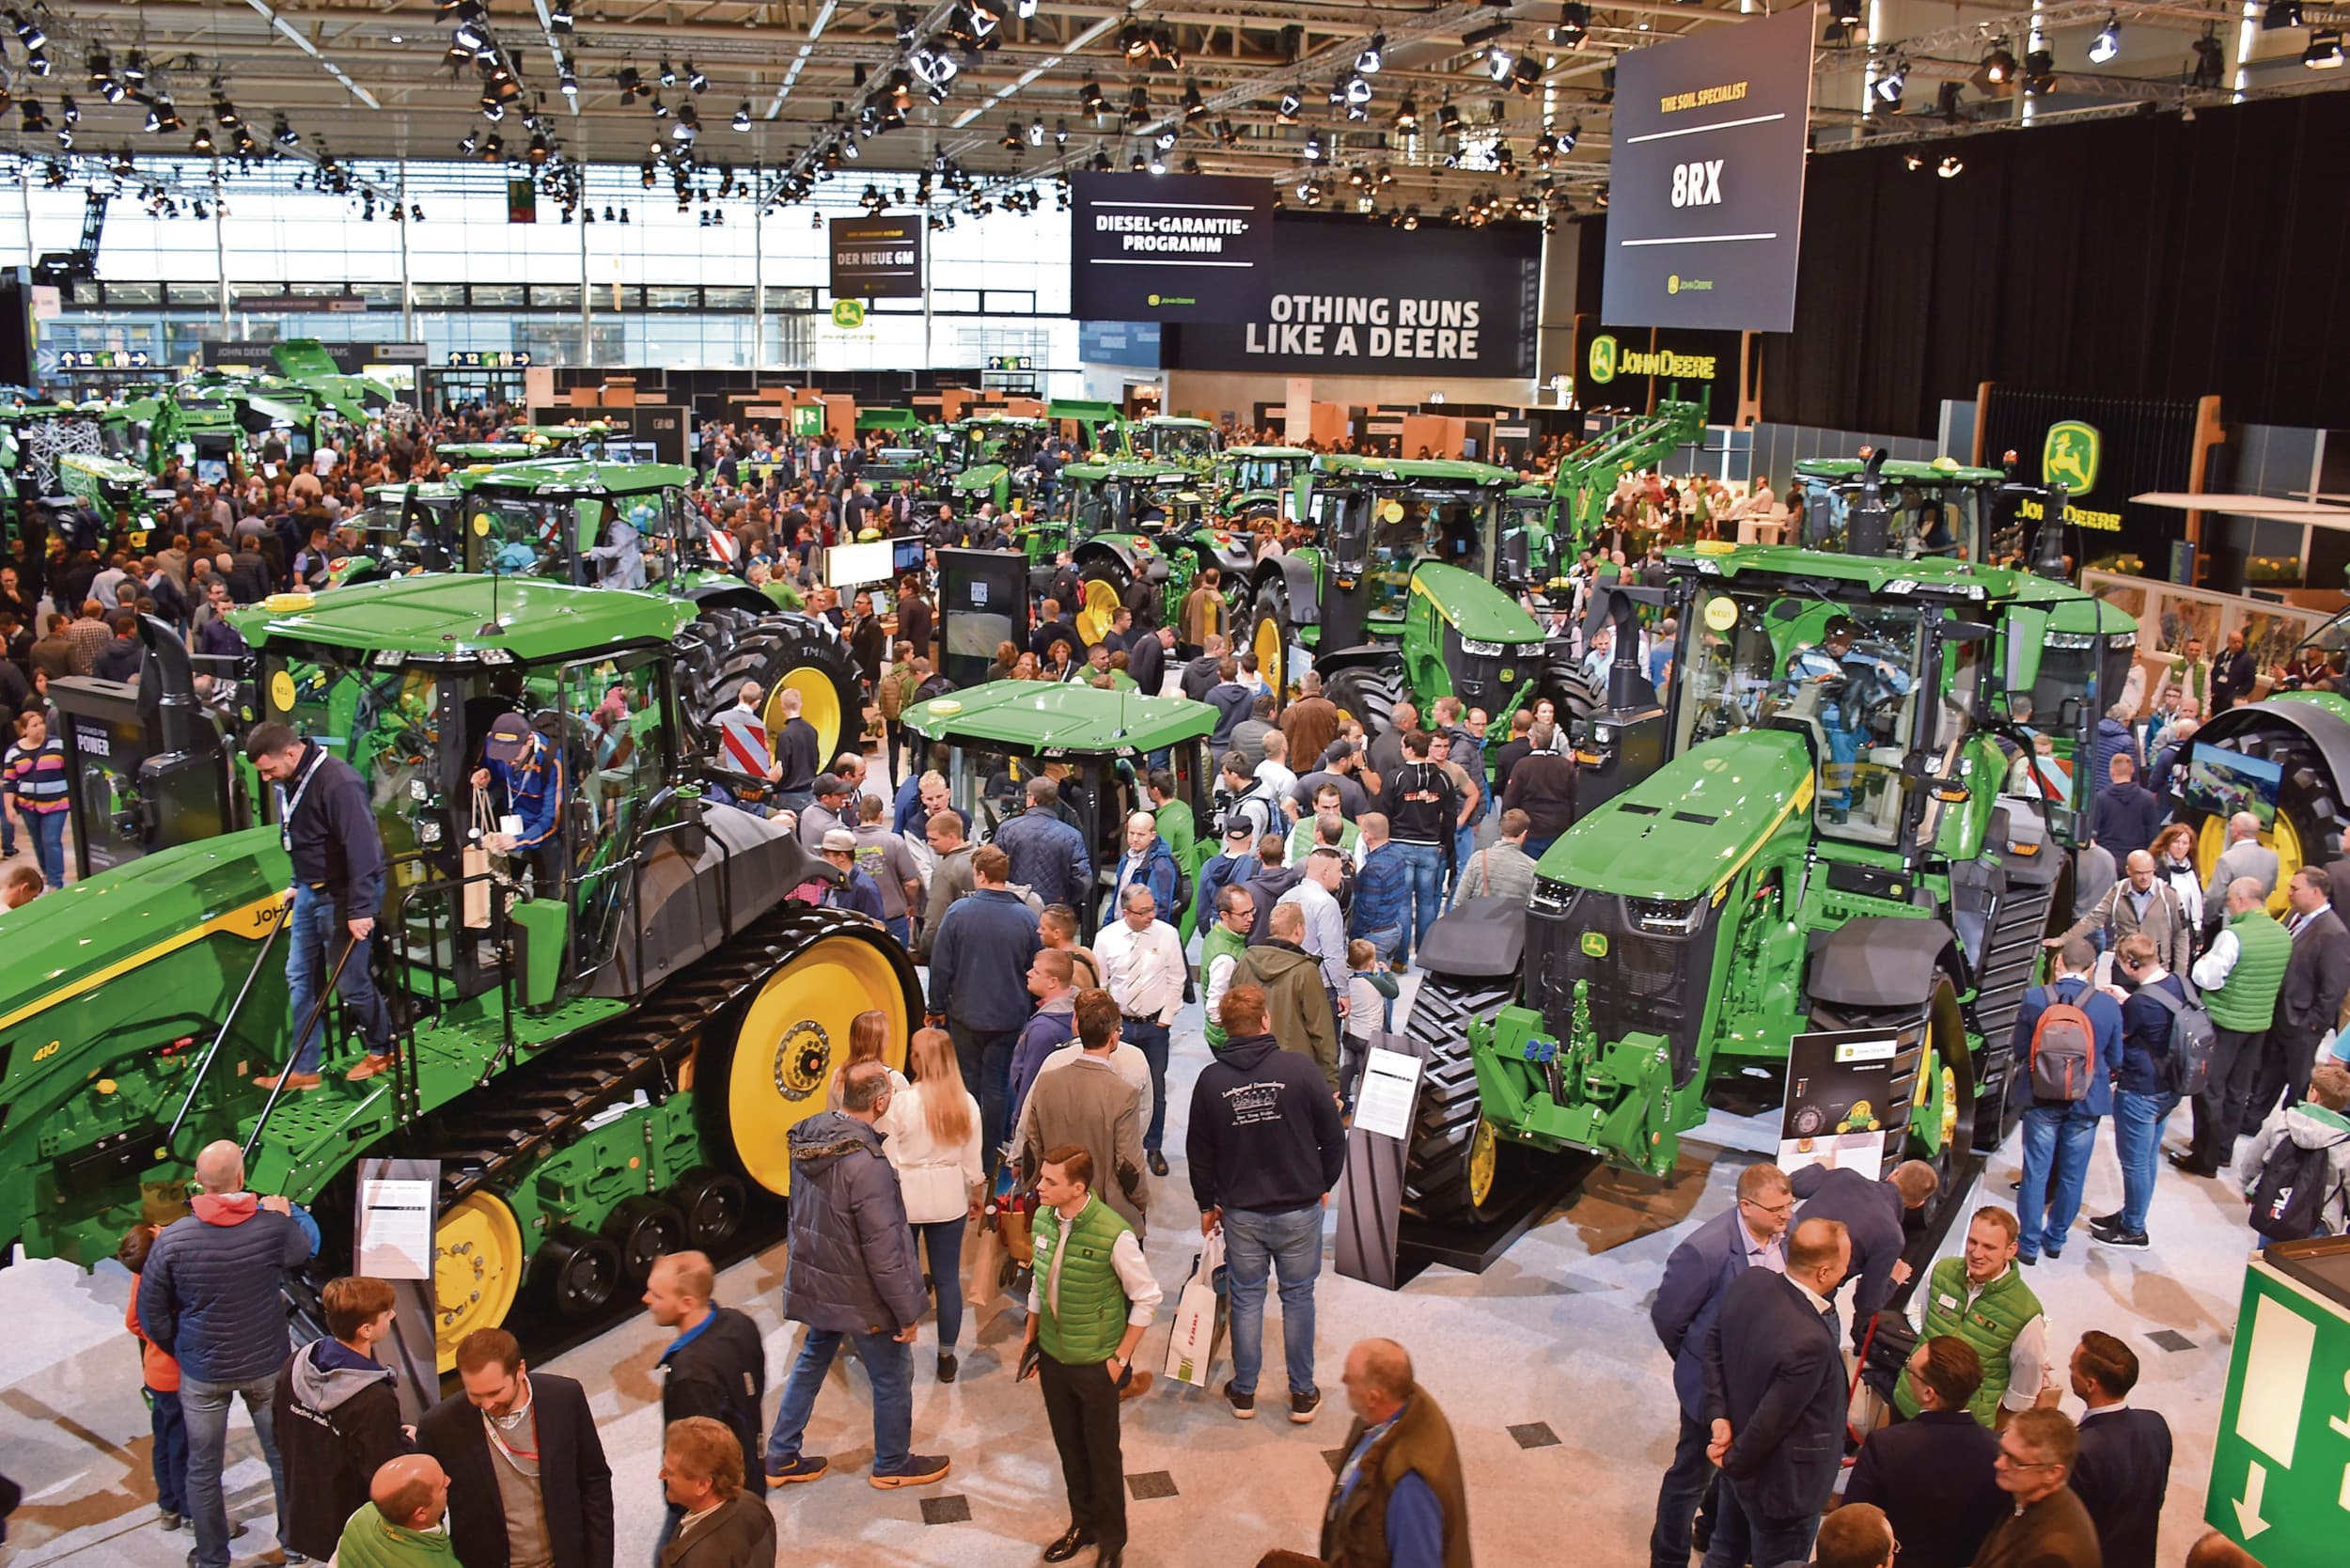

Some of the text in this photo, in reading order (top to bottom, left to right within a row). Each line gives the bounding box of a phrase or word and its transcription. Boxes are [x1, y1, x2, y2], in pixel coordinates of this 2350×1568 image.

[1661, 82, 1748, 113] THE SOIL SPECIALIST
[1670, 160, 1724, 208] 8RX
[1096, 215, 1249, 235] DIESEL-GARANTIE-
[1123, 235, 1222, 253] PROGRAMM
[837, 251, 915, 265] DER NEUE 6M
[1270, 293, 1480, 329] OTHING RUNS
[1246, 322, 1480, 359] LIKE A DEERE
[466, 353, 479, 365] 12
[1618, 348, 1716, 379] JOHN DEERE
[2014, 498, 2122, 532] JO DEERE
[77, 734, 110, 757] POWER
[253, 903, 285, 927] JOH
[32, 1040, 61, 1062] 410
[2270, 1187, 2294, 1220] FILA
